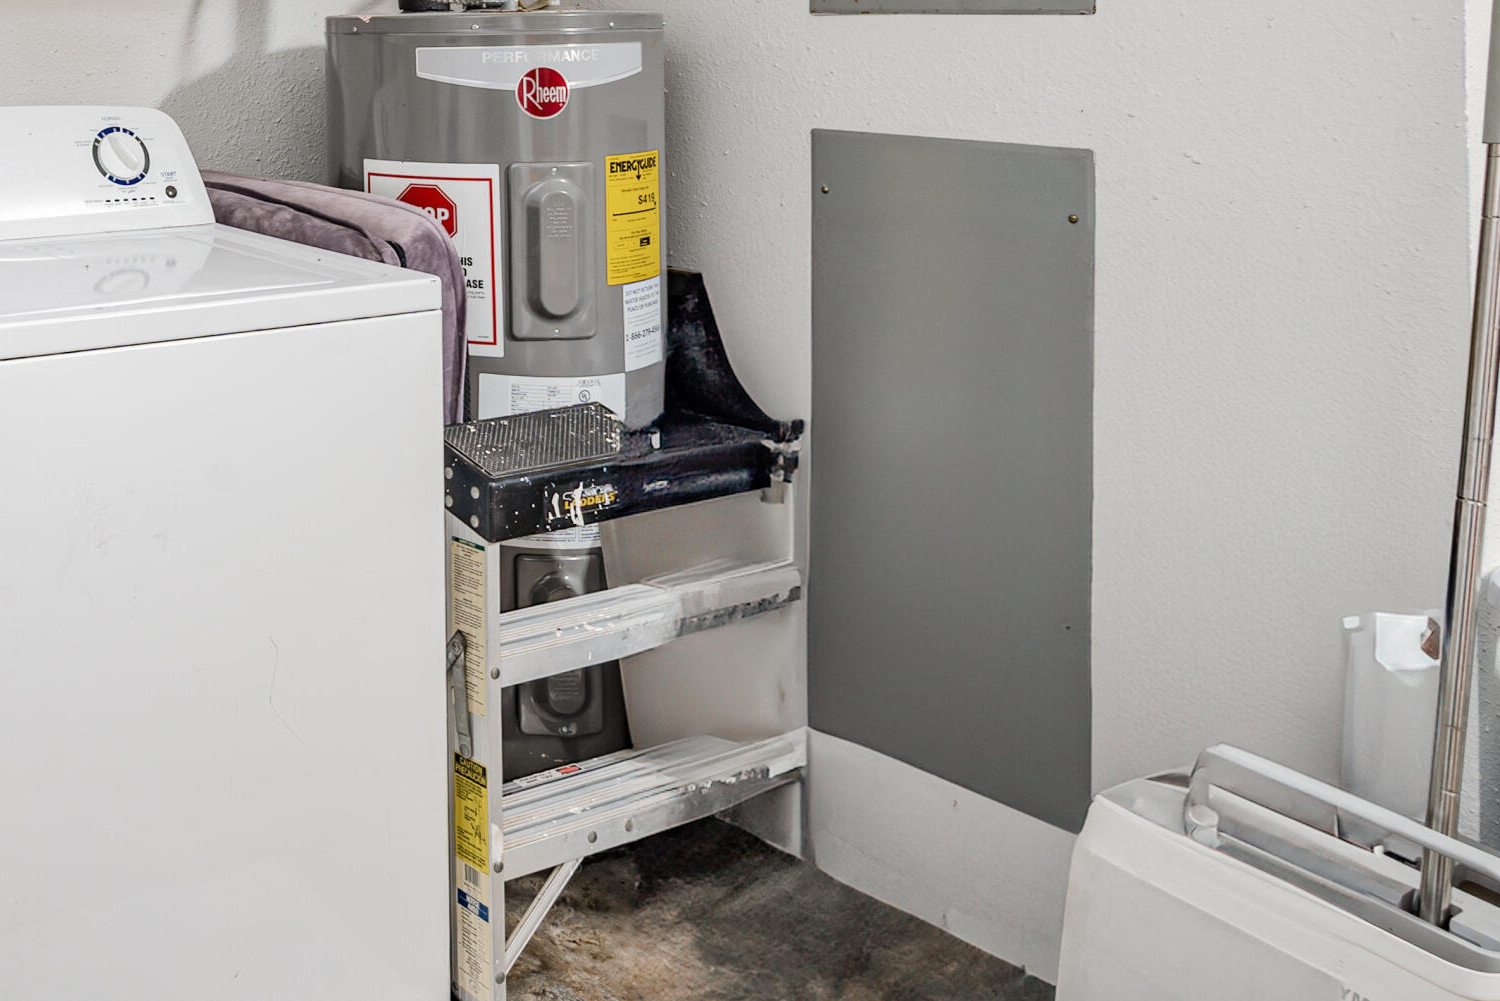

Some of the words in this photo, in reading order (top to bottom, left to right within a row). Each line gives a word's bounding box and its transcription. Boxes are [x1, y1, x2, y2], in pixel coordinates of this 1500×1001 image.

[522, 68, 568, 110] Rheem
[423, 207, 450, 222] OP
[460, 256, 473, 266] HIS
